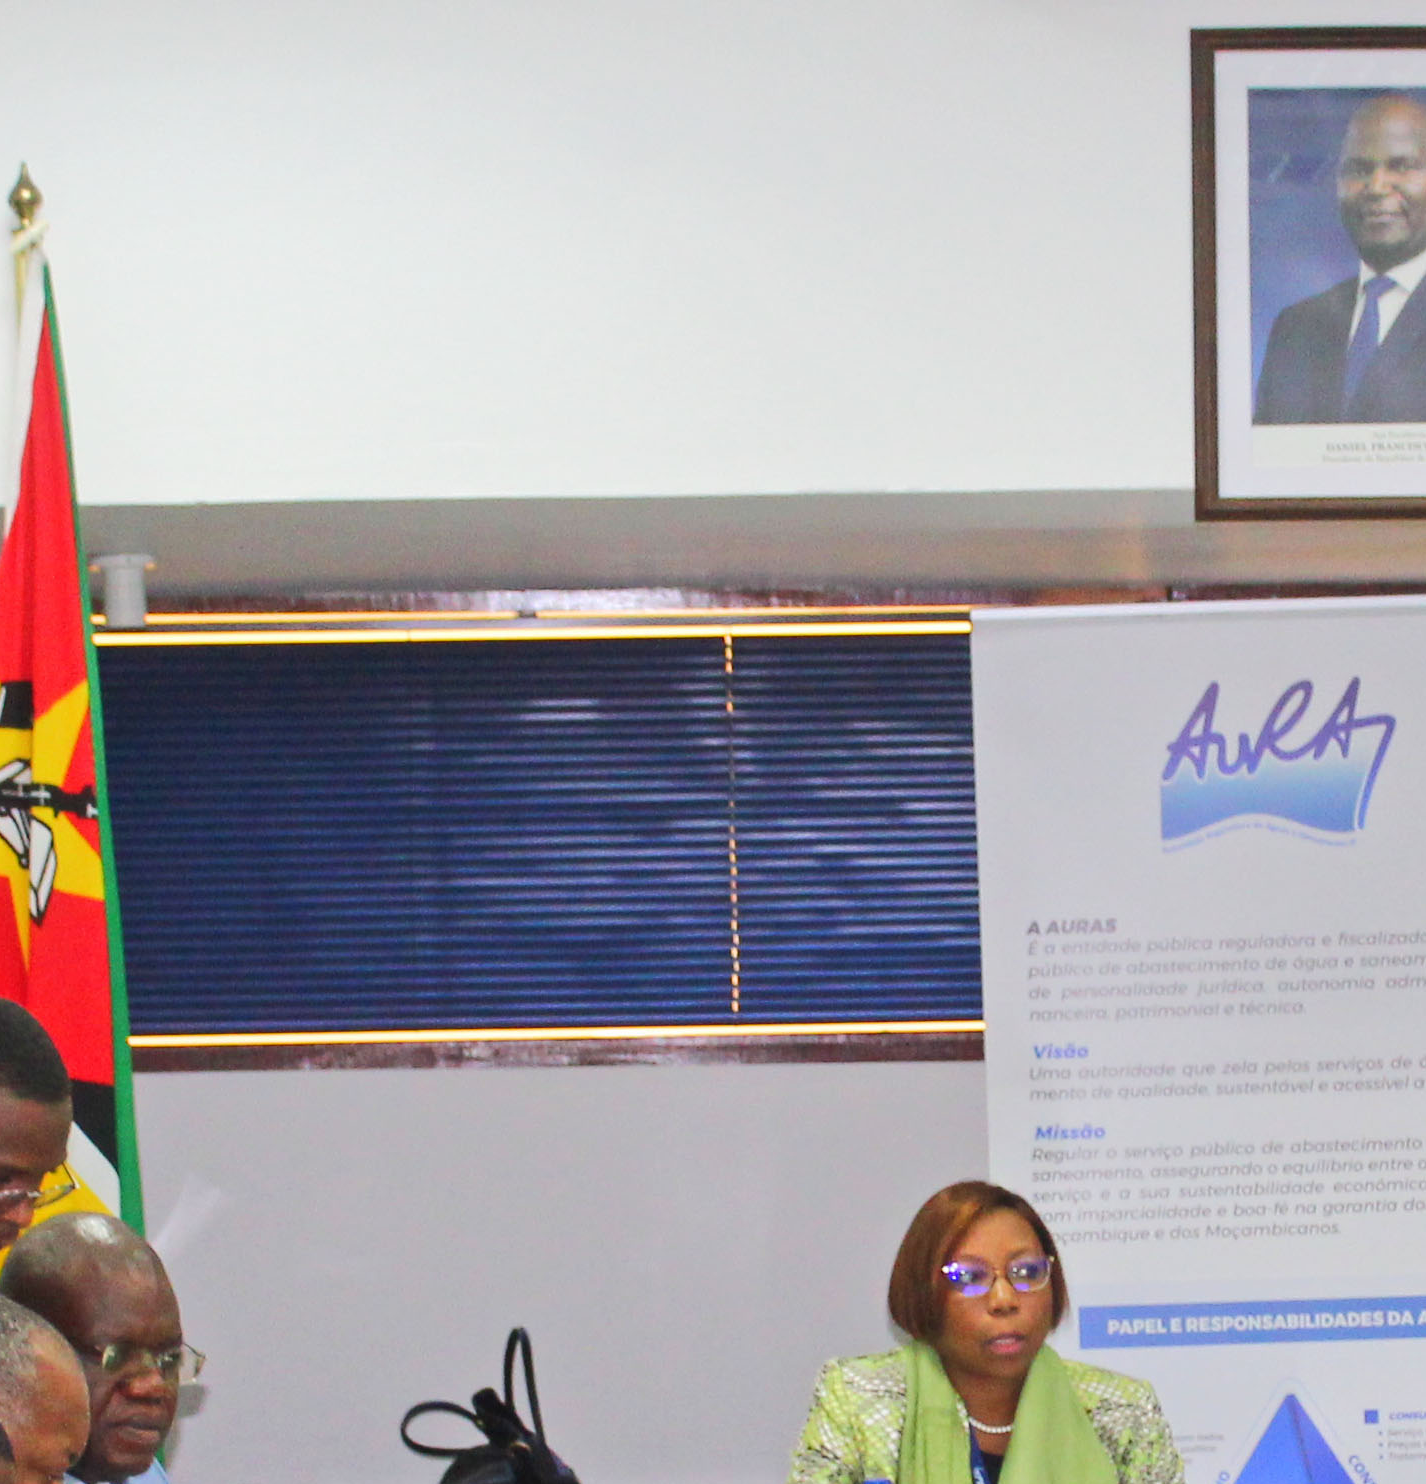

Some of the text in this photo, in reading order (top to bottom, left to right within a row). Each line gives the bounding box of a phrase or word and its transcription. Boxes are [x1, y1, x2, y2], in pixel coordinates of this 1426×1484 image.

[1027, 918, 1118, 935] A AURAS
[1044, 943, 1055, 955] a
[1061, 938, 1141, 954] entidade
[1147, 935, 1213, 955] pública
[1219, 932, 1316, 953] reguladora
[1321, 935, 1332, 947] e
[1028, 959, 1094, 979] público
[1098, 960, 1121, 976] de
[1126, 957, 1260, 975] abastecimento
[1265, 955, 1287, 970] de
[1292, 953, 1339, 972] água
[1344, 957, 1354, 968] e
[1028, 985, 1051, 1001] de
[1060, 981, 1189, 1001] personalidade
[1278, 975, 1375, 993] autonomia
[1115, 1001, 1220, 1022] patrimonial
[1224, 1005, 1234, 1017] e
[1033, 1043, 1090, 1060] Visão
[1029, 1066, 1072, 1081] Uma
[1078, 1062, 1176, 1079] autoridade
[1182, 1064, 1216, 1080] que
[1222, 1060, 1259, 1076] zela
[1263, 1059, 1311, 1077] pelas
[1316, 1056, 1385, 1074] serviços
[1391, 1055, 1413, 1070] de
[1030, 1085, 1087, 1101] mento
[1091, 1083, 1114, 1099] de
[1216, 1076, 1314, 1097] sustentável
[1318, 1080, 1329, 1093] e
[1414, 1077, 1425, 1090] a
[1035, 1123, 1106, 1141] Missão
[1031, 1145, 1099, 1164] Regular
[1106, 1148, 1117, 1161] o
[1124, 1144, 1183, 1162] serviço
[1190, 1141, 1256, 1160] público
[1262, 1140, 1284, 1155] de
[1291, 1136, 1423, 1154] abastecimento
[1150, 1160, 1263, 1181] assegurando
[1268, 1163, 1278, 1175] o
[1368, 1156, 1415, 1172] entre
[1033, 1186, 1092, 1205] serviço
[1100, 1188, 1110, 1200] e
[1119, 1187, 1131, 1200] a
[1139, 1185, 1171, 1200] sua
[1180, 1179, 1325, 1199] sustentabilidade
[1042, 1211, 1072, 1223] om
[1077, 1201, 1214, 1223] imparcialidade
[1294, 1202, 1318, 1216] na
[1323, 1197, 1398, 1217] garantia
[1053, 1226, 1151, 1246] oçambique
[1155, 1227, 1165, 1240] e
[1169, 1223, 1201, 1240] dos
[1107, 1317, 1167, 1336] PAPEL
[1170, 1316, 1182, 1334] E
[1185, 1310, 1384, 1333] RESPONSABILIDADES
[1387, 1309, 1414, 1327] DA
